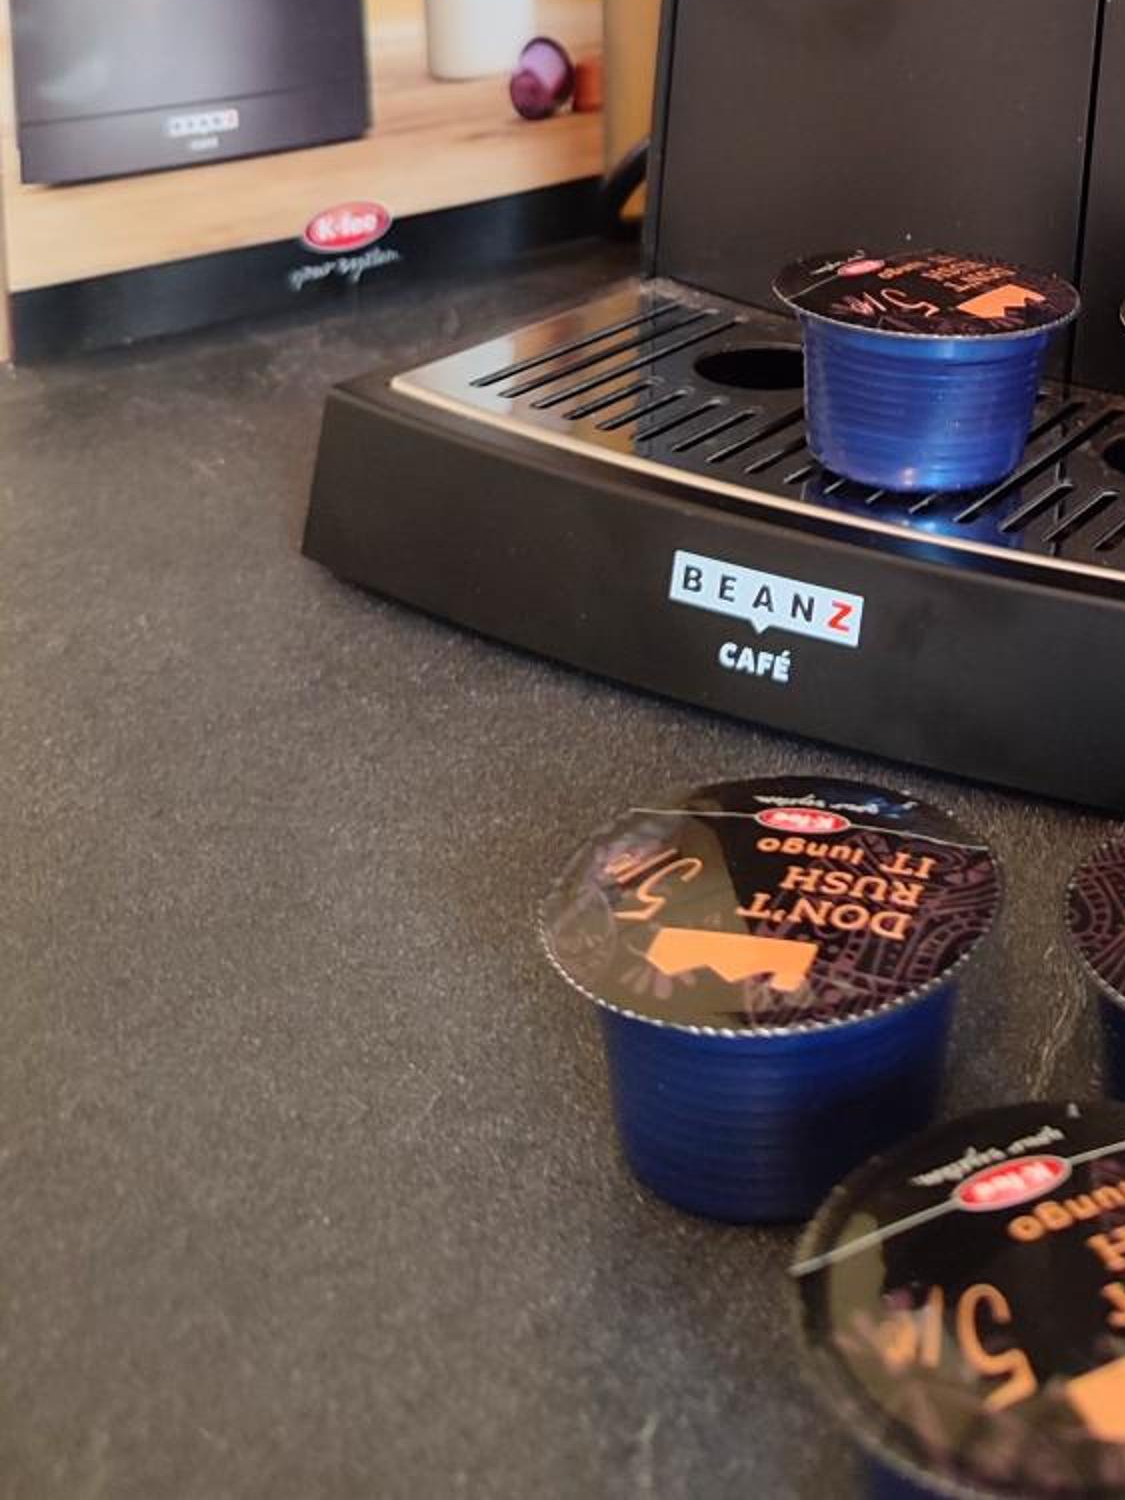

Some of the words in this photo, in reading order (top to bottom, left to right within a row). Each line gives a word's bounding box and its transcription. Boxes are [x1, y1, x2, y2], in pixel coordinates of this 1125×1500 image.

[682, 565, 856, 632] BEANZ
[718, 642, 792, 683] CAFÉ
[756, 836, 865, 865] lungo
[880, 851, 938, 880] IT
[779, 866, 925, 908] RUSH
[737, 891, 912, 940] DON'T
